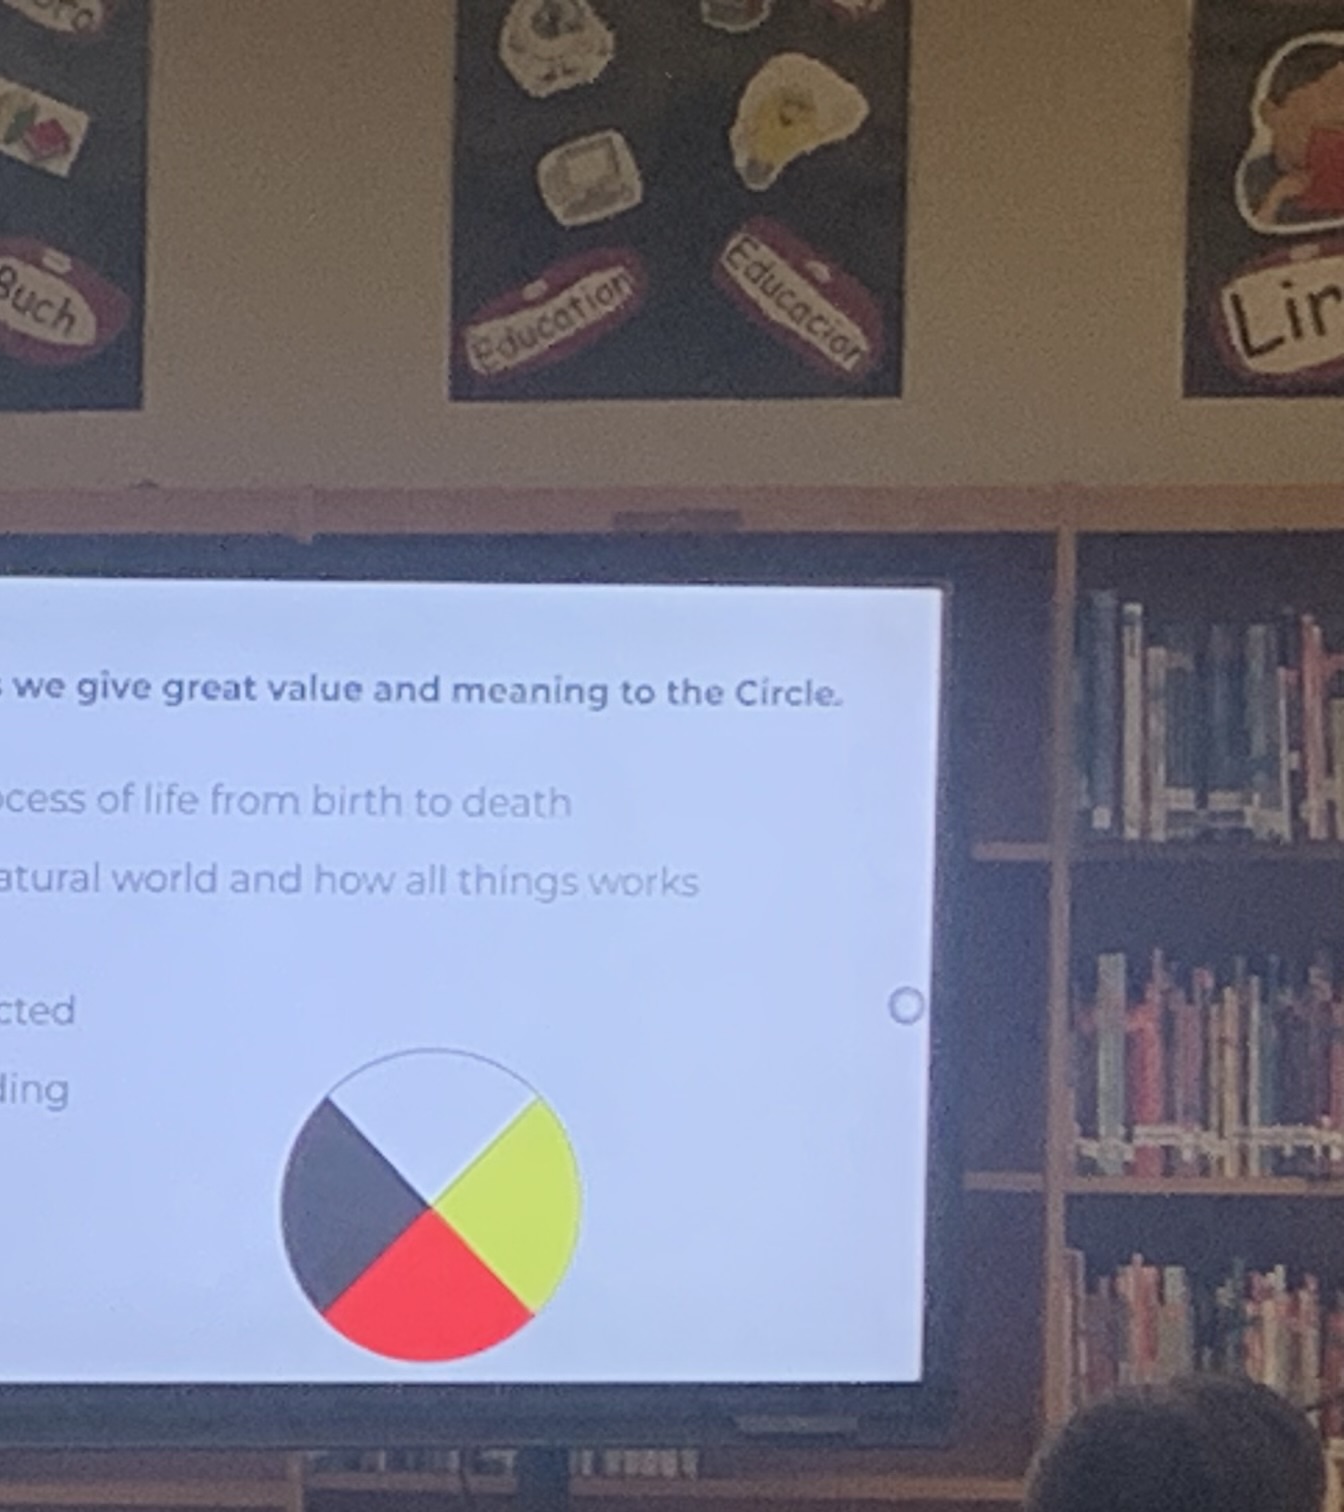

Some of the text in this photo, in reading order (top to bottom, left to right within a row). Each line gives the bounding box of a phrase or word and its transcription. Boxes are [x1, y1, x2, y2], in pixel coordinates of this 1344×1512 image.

[472, 272, 635, 371] Education
[11, 677, 67, 700] we
[75, 668, 153, 707] give
[161, 675, 258, 708] great
[266, 672, 364, 703] value
[373, 674, 441, 704] and
[451, 674, 609, 713] meaning
[620, 680, 657, 706] to
[666, 677, 725, 707] the
[734, 677, 843, 708] Circle.
[96, 781, 135, 815] of
[145, 782, 200, 815] life
[211, 783, 300, 817] from
[312, 784, 402, 816] birth
[415, 789, 453, 818] to
[462, 787, 571, 819] death
[111, 861, 218, 894] world
[229, 863, 302, 895] and
[315, 863, 396, 895] how
[406, 864, 446, 895] all
[458, 865, 579, 904] things
[589, 866, 699, 897] works
